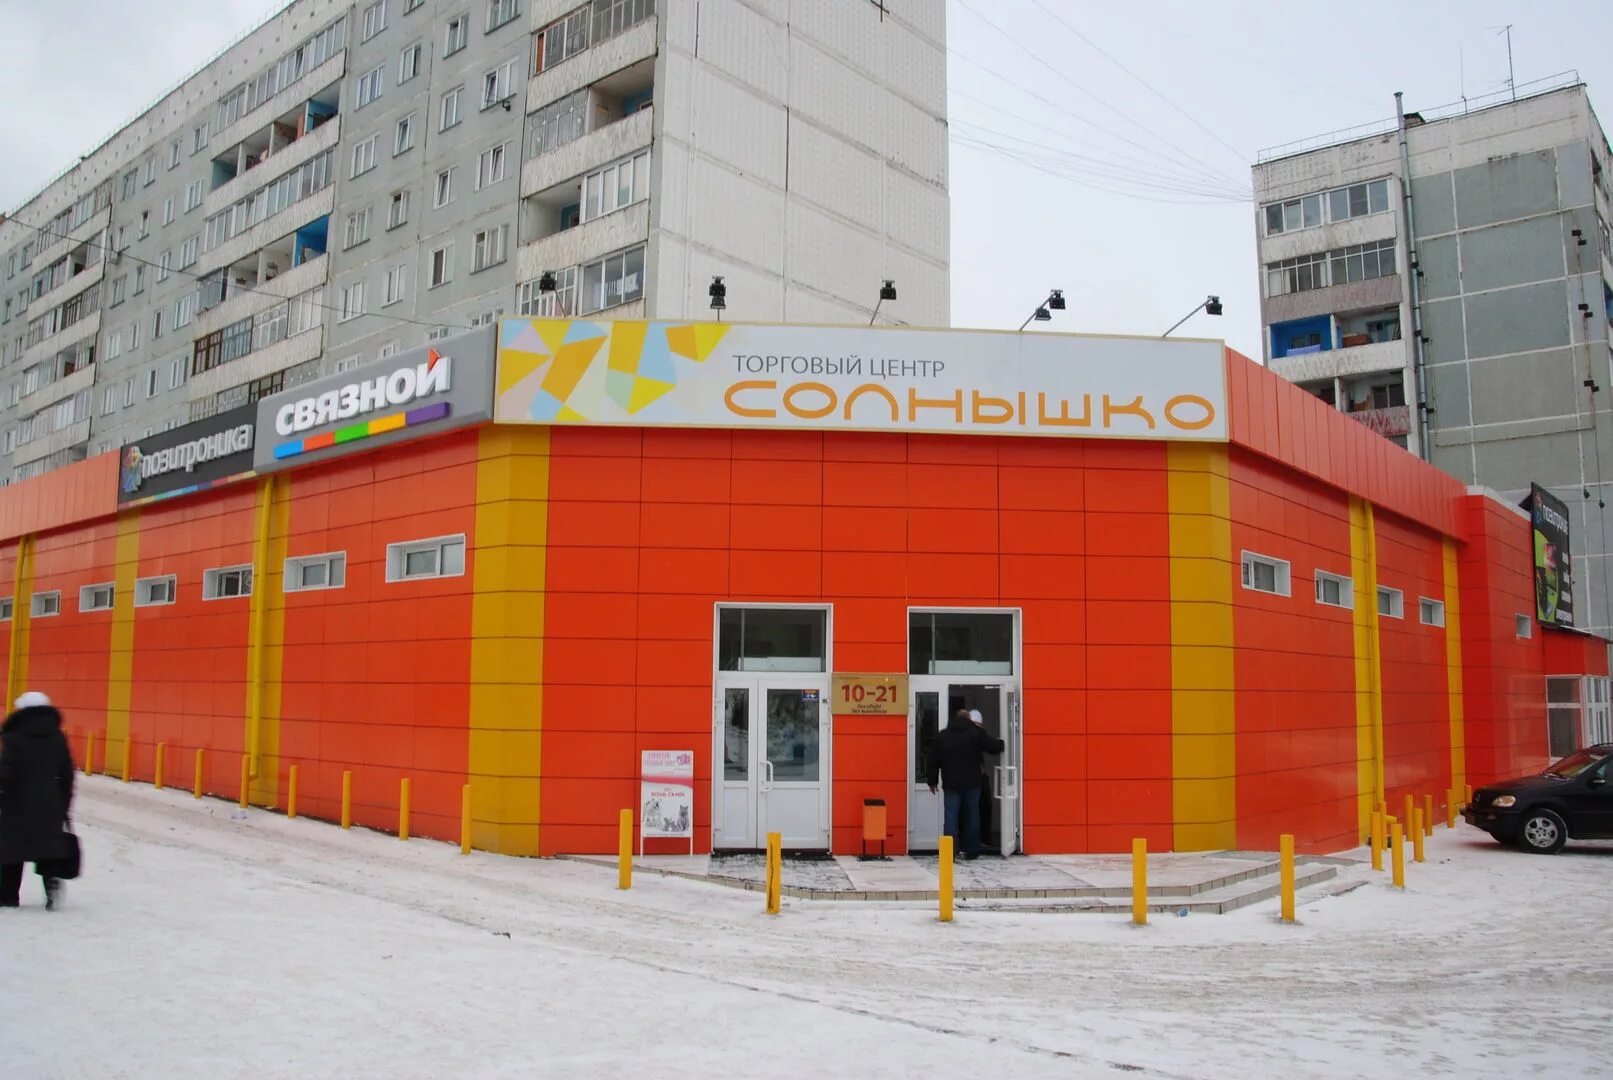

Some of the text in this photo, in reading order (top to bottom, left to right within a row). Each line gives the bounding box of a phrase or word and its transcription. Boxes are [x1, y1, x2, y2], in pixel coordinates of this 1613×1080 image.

[732, 353, 945, 380] ТОРГОВЫЙ ЦЕНТР
[275, 348, 453, 435] СВЯЗНОЙ
[724, 380, 1215, 429] СОЛНЫШКО
